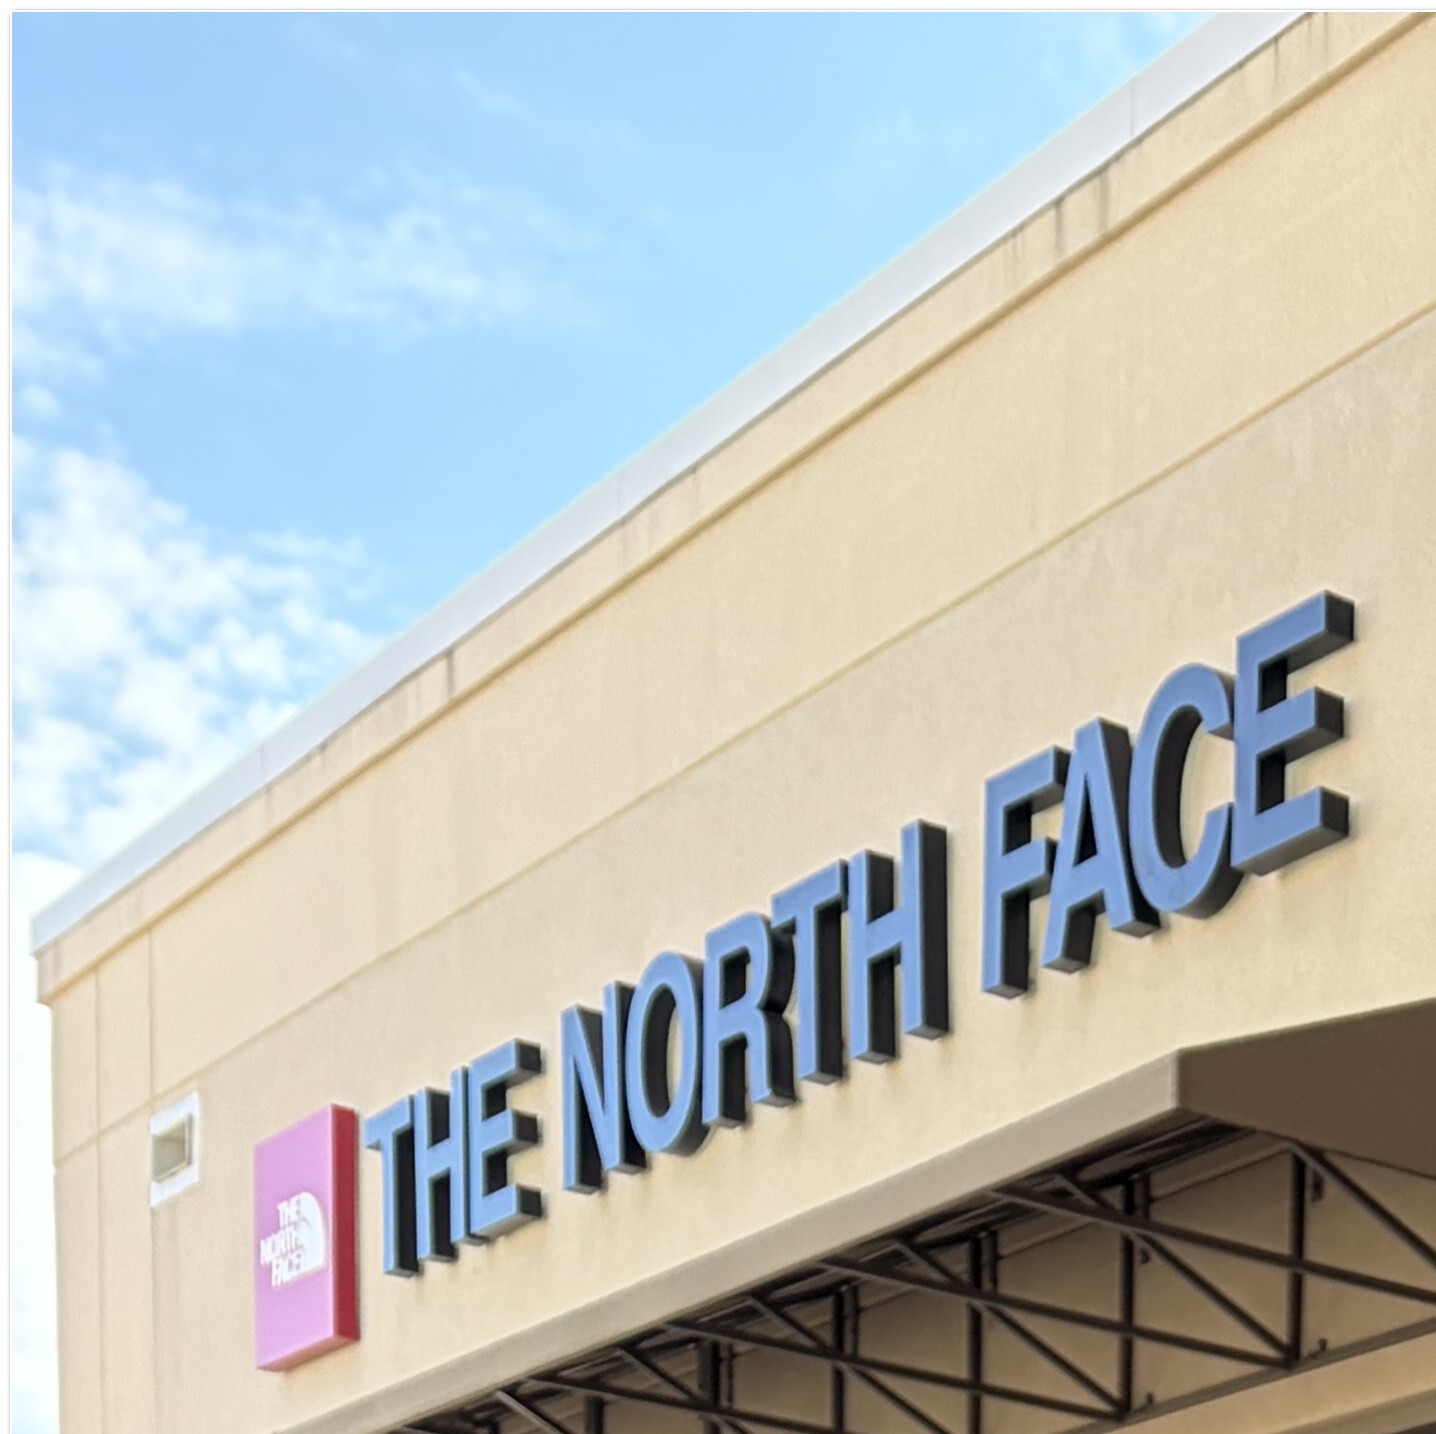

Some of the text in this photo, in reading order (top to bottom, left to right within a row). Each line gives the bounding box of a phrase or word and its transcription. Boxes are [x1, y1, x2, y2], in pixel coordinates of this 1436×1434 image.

[364, 590, 1355, 1277] THE NORTH FACE
[277, 1194, 301, 1229] THE
